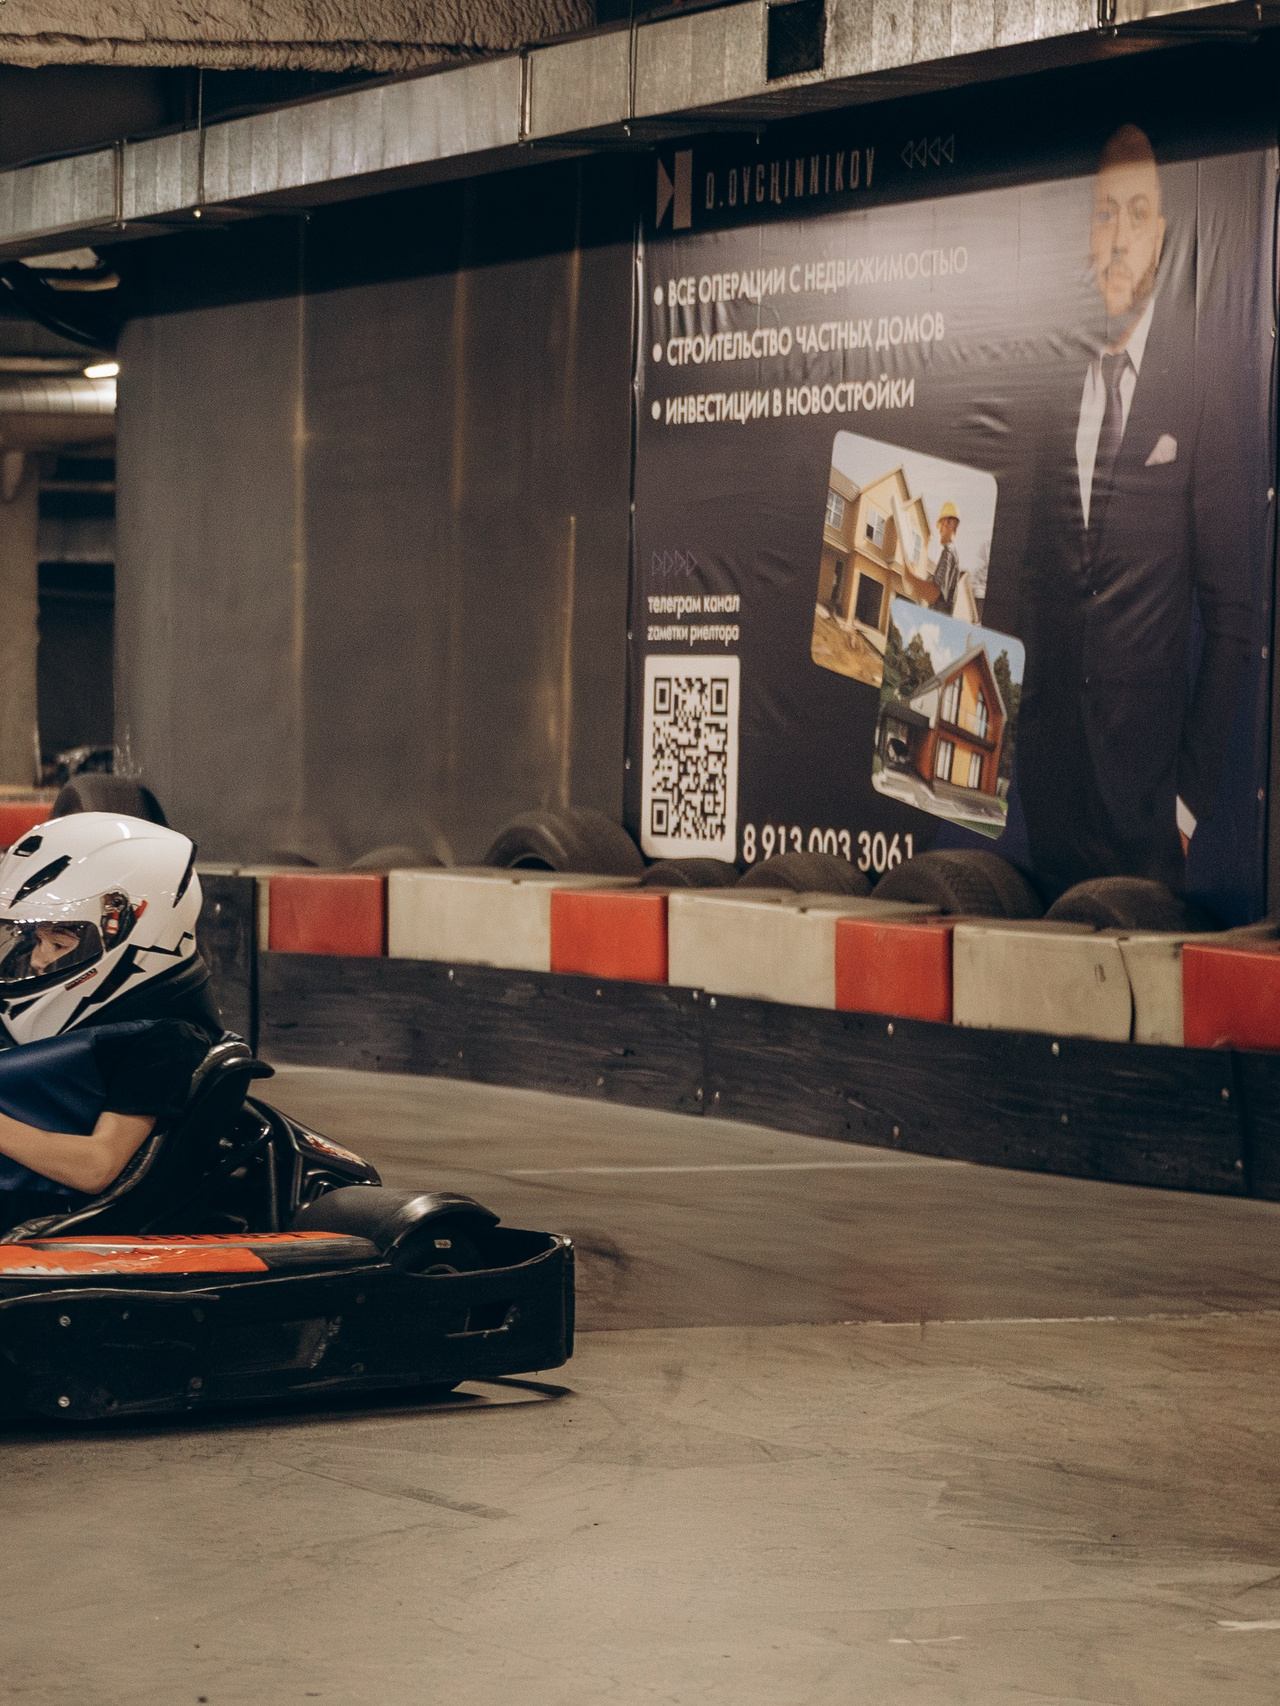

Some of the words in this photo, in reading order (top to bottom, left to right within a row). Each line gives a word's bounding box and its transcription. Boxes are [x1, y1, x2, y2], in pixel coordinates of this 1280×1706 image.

[668, 276, 696, 307] ВСЕ
[698, 267, 786, 304] ОПЕРАЦИИ
[789, 264, 802, 293] С
[804, 246, 968, 295] НЕДВИЖИМОСТЬЮ
[667, 327, 792, 366] СТРОИТЕЛЬСТВО
[796, 319, 872, 353] ЧАСТНЫХ
[875, 312, 944, 351] ДОМОВ
[665, 390, 769, 425] ИНВЕСТИЦИИ
[772, 388, 783, 417] В
[785, 373, 915, 416] НОВОСТРОЙКИ
[647, 594, 701, 620] телеграм
[703, 593, 740, 613] канал
[743, 822, 756, 864] 8
[761, 824, 803, 861] 913
[858, 830, 913, 873] 3061
